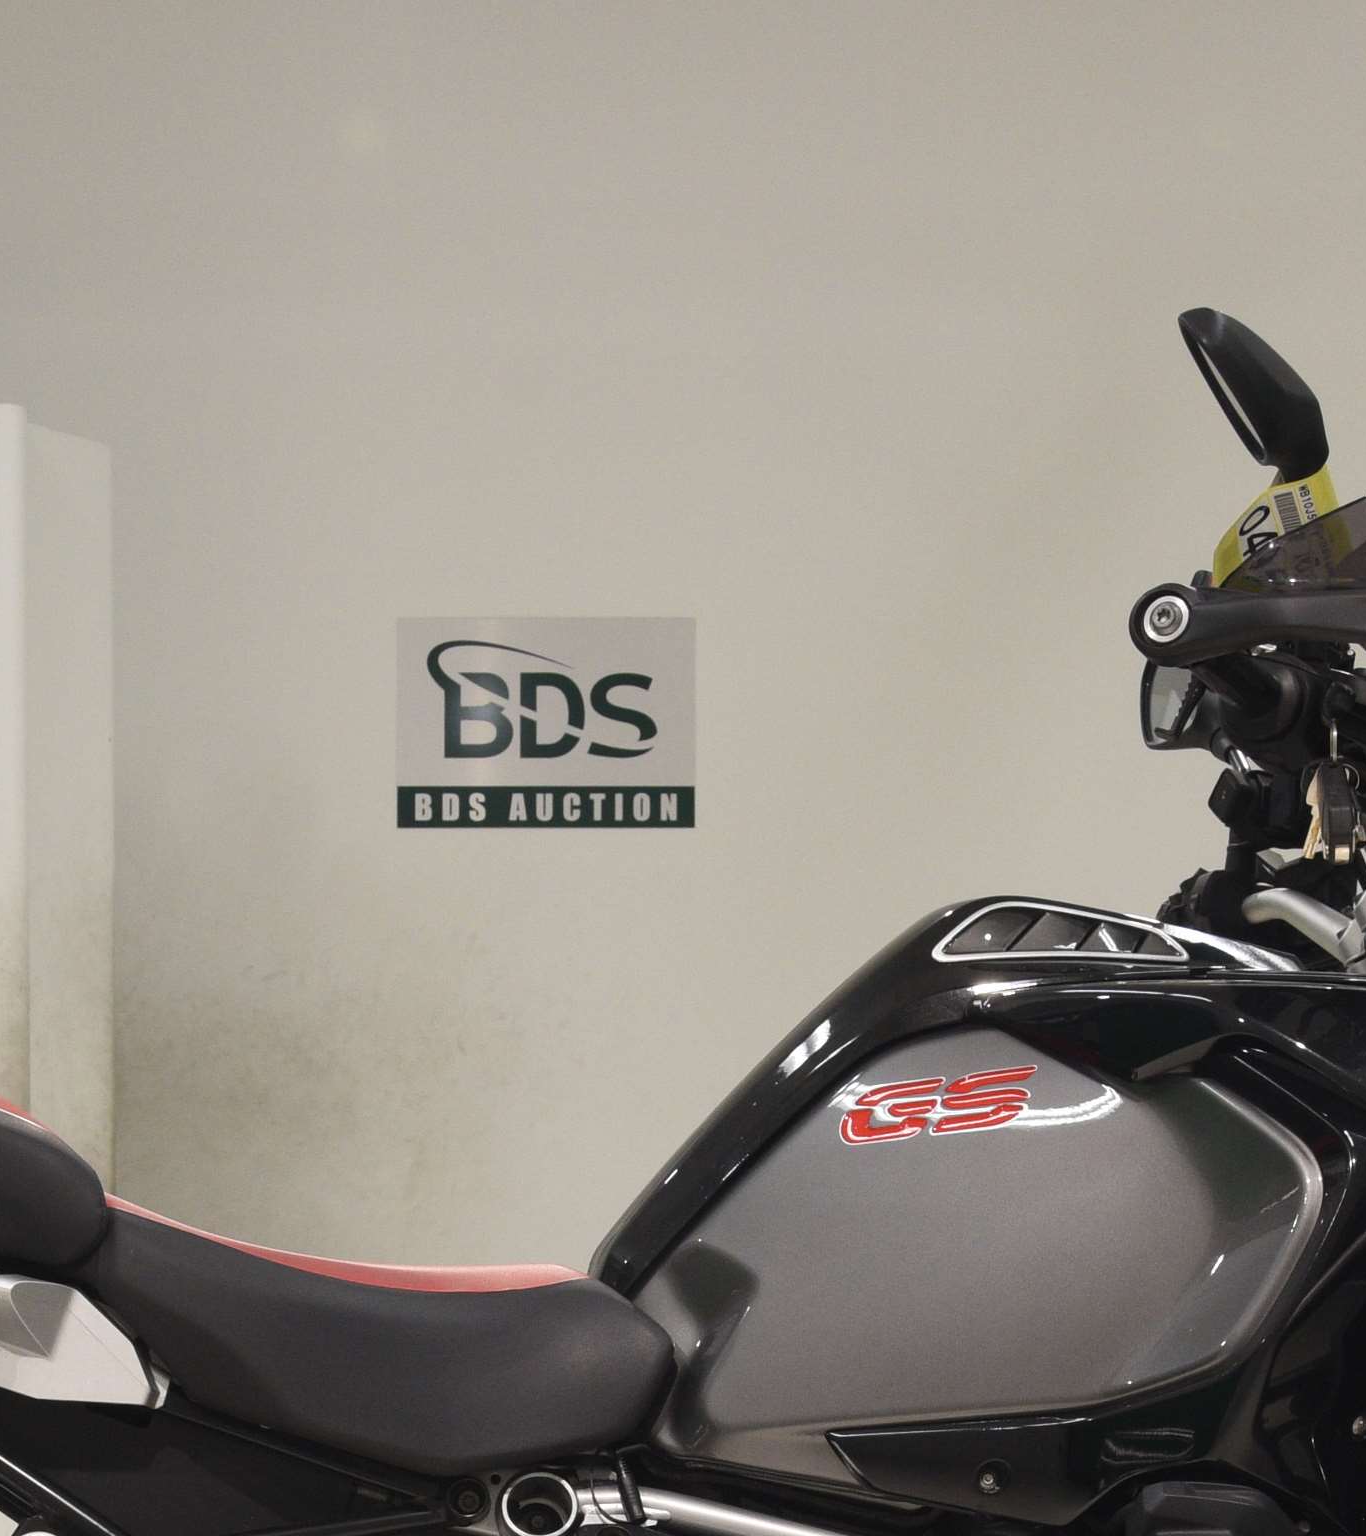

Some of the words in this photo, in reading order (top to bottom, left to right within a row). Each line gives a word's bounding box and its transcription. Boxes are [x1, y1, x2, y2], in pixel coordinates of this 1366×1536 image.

[427, 640, 658, 758] BDS
[414, 792, 486, 822] BDS
[508, 792, 678, 822] AUCTION
[839, 1064, 1037, 1145] GS
